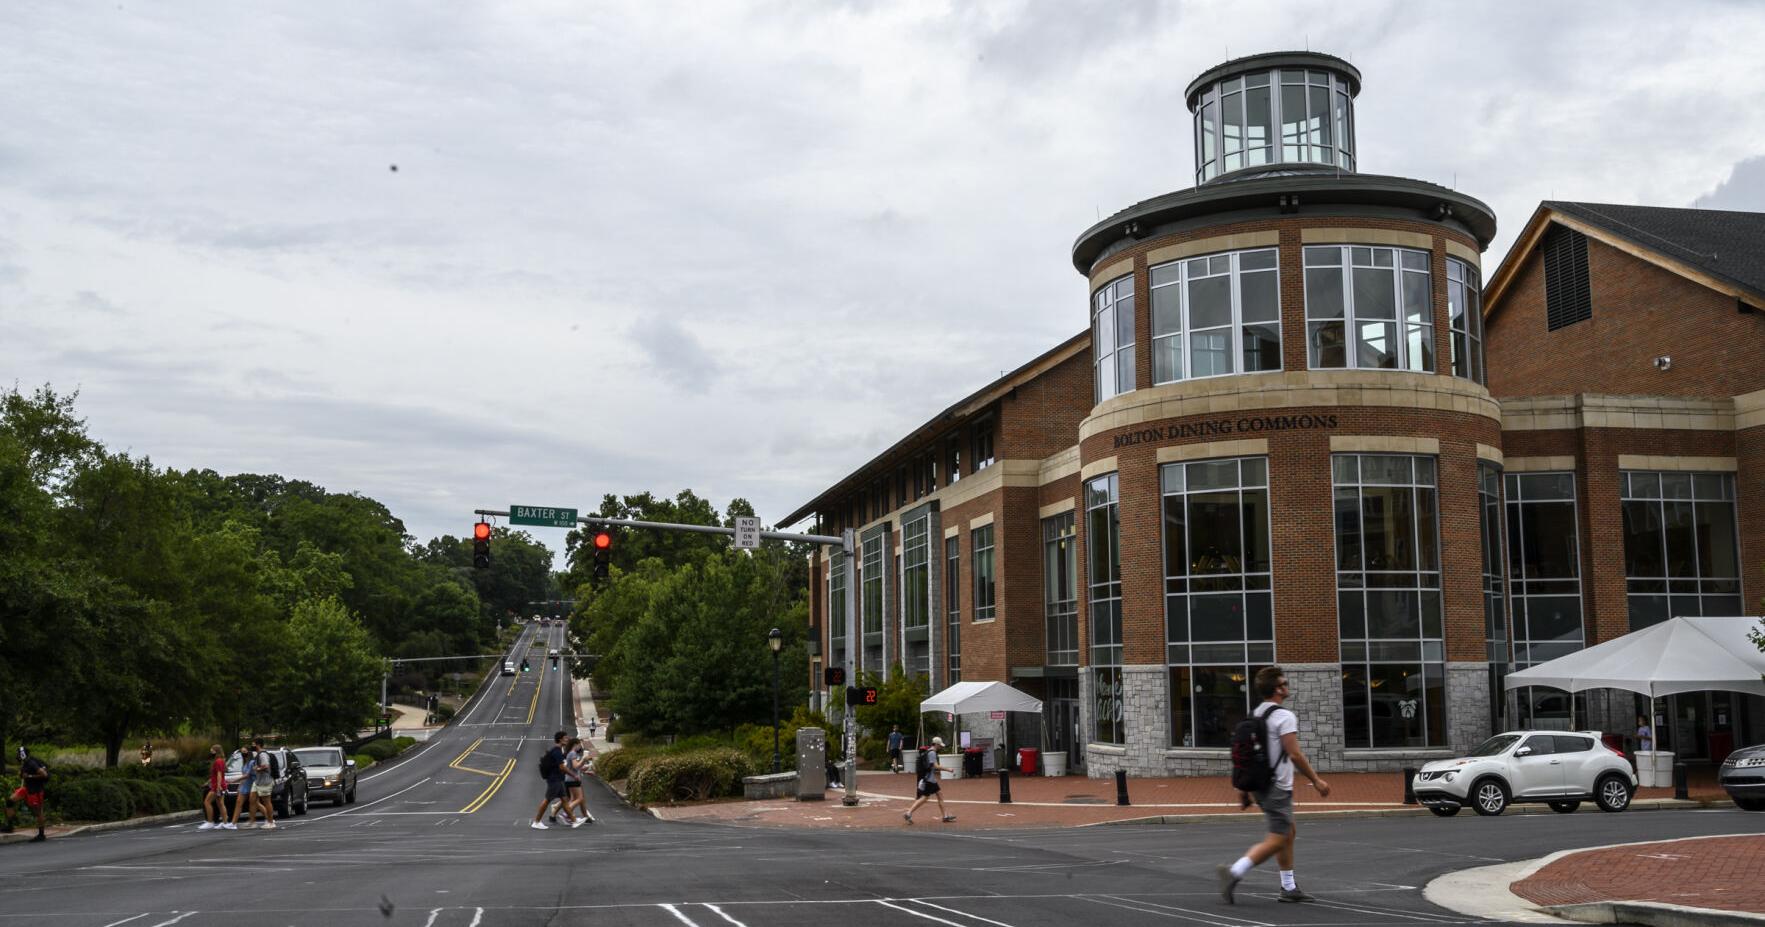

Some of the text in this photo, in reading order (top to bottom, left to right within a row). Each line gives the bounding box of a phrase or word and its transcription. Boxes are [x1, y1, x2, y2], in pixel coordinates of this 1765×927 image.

[1113, 414, 1339, 449] BOLTON DINING COMMONS
[517, 507, 570, 520] BAXTER ST
[865, 689, 877, 703] 22
